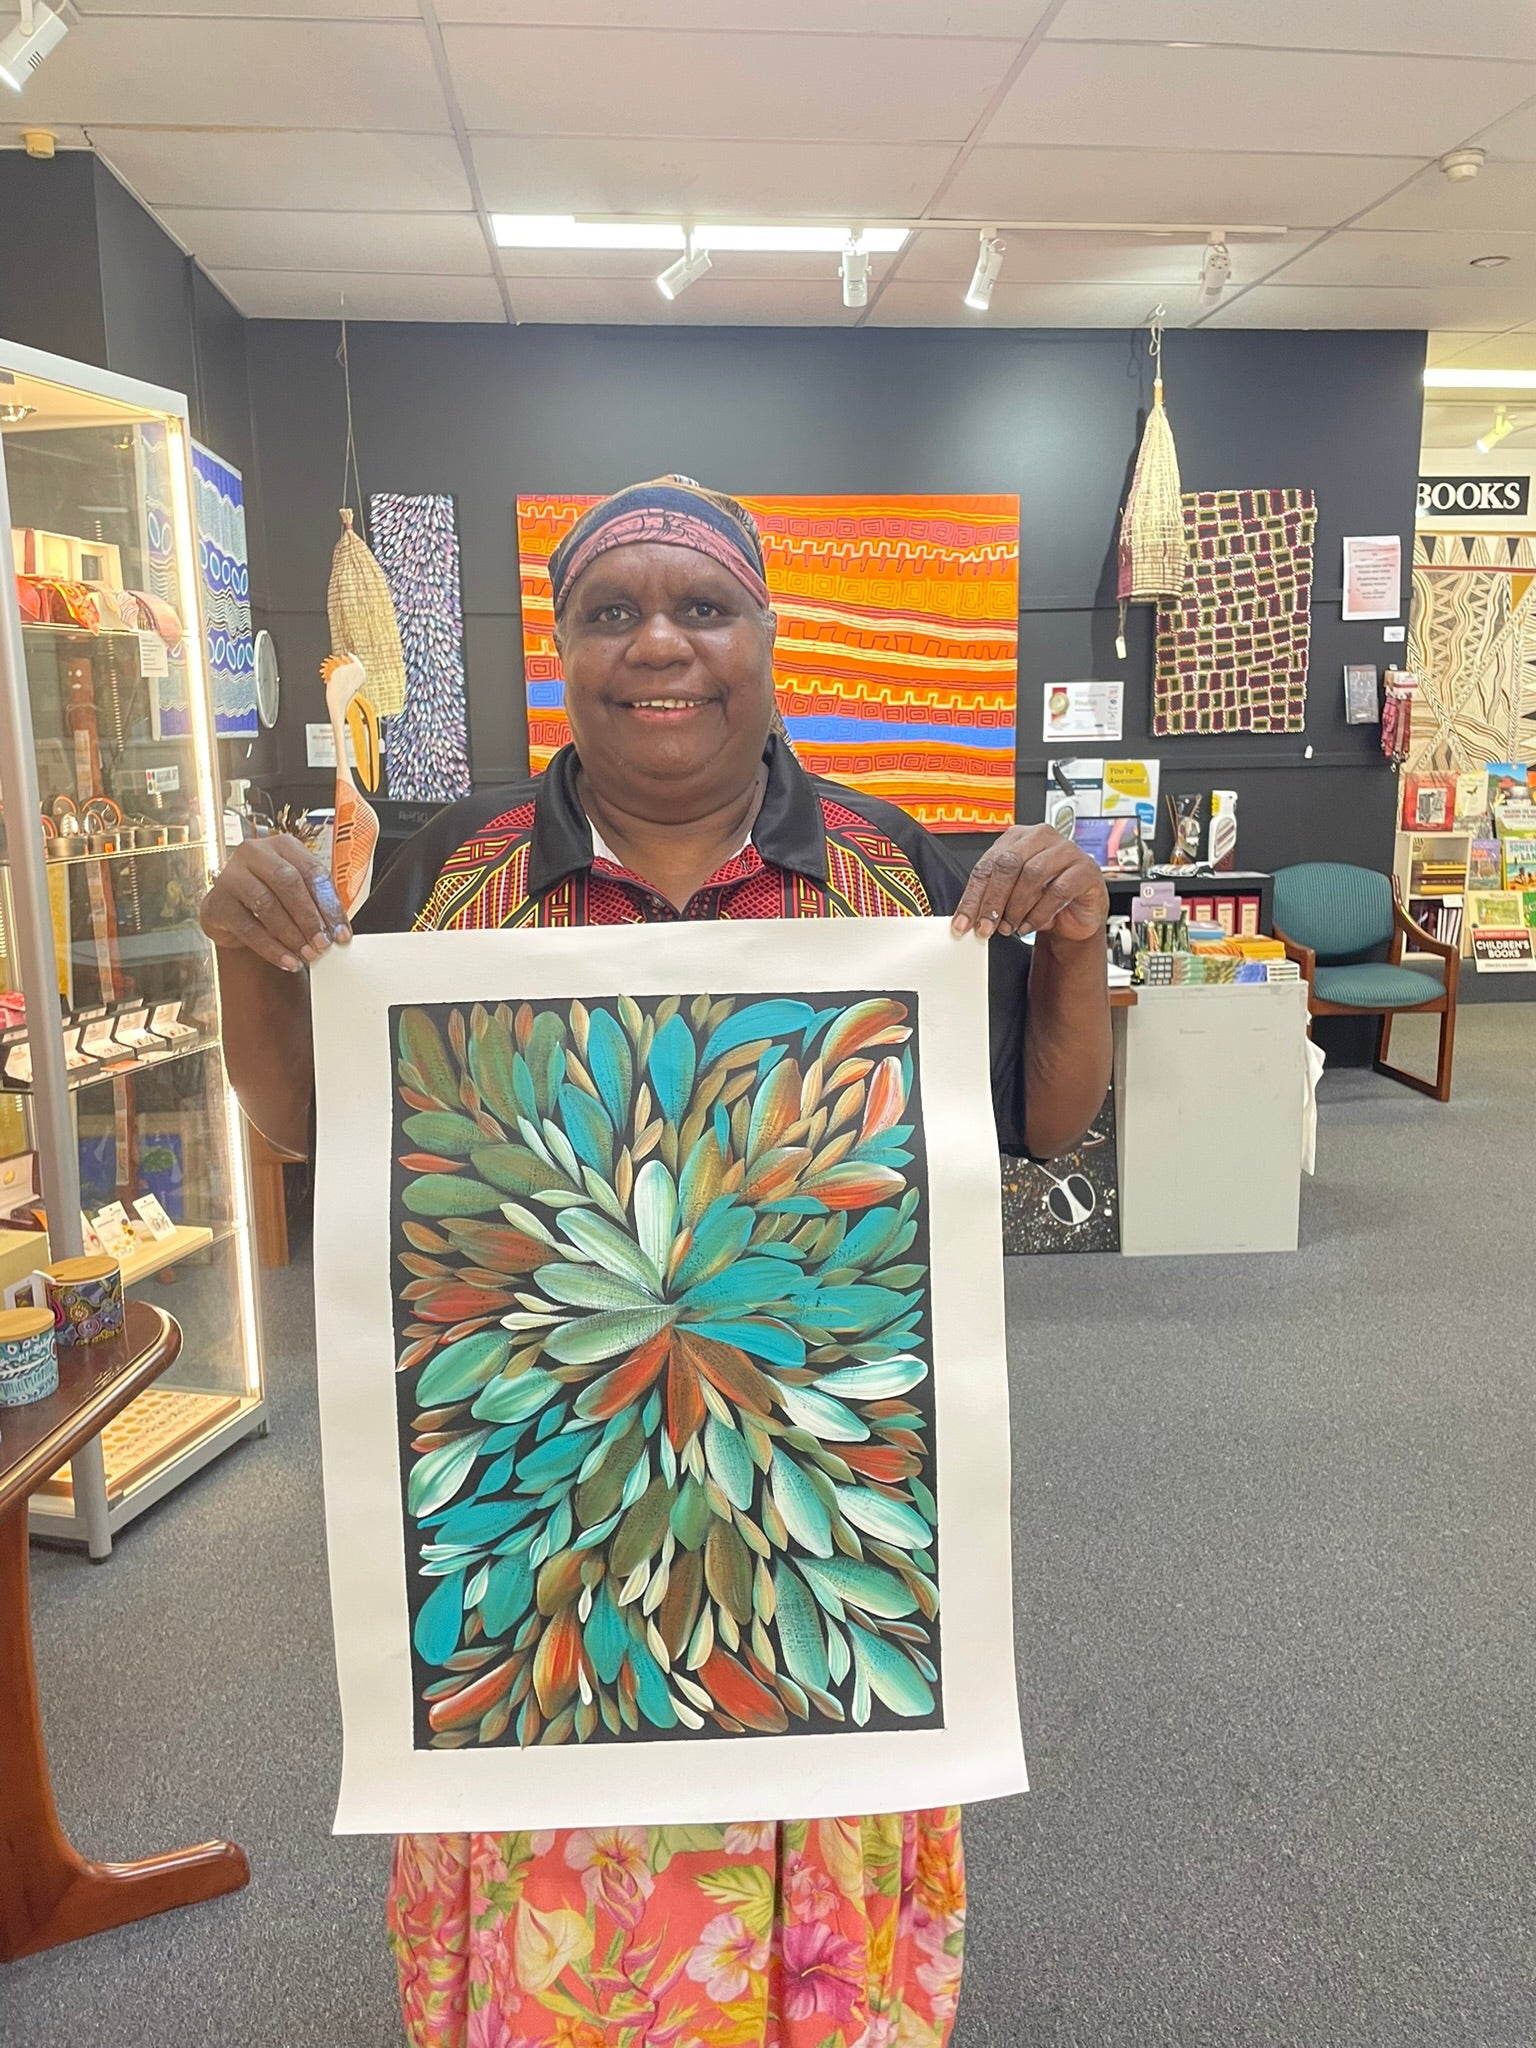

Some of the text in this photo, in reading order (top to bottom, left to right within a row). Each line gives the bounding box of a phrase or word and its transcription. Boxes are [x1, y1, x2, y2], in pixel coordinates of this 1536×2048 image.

[1417, 482, 1520, 510] BOOKS
[1476, 940, 1530, 950] CHILDREN'S
[1488, 949, 1521, 958] BOOKS
